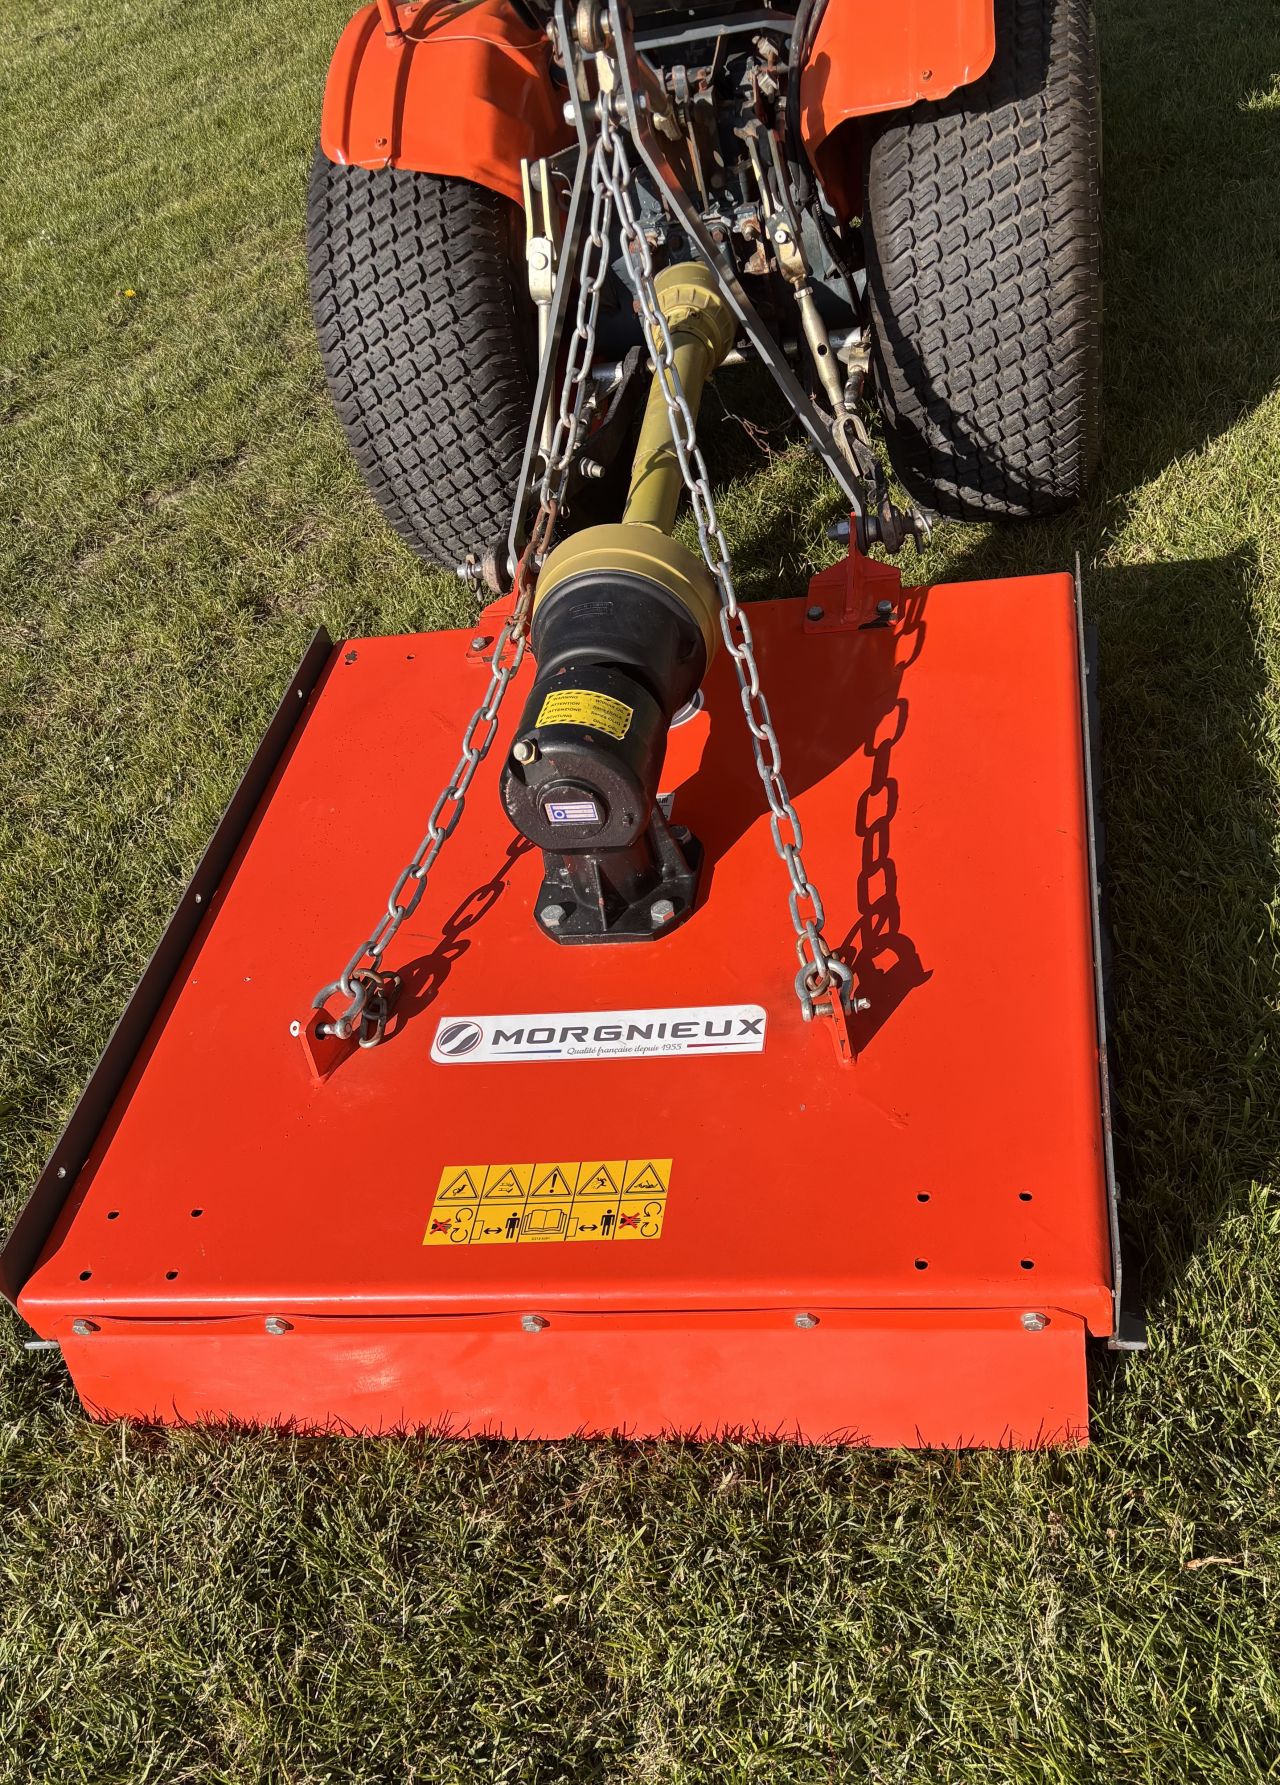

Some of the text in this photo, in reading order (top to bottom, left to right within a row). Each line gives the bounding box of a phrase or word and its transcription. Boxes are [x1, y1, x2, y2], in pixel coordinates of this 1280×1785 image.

[492, 1018, 764, 1046] MORGNIEUX
[567, 1043, 682, 1057] Qualité française depuis 1955
